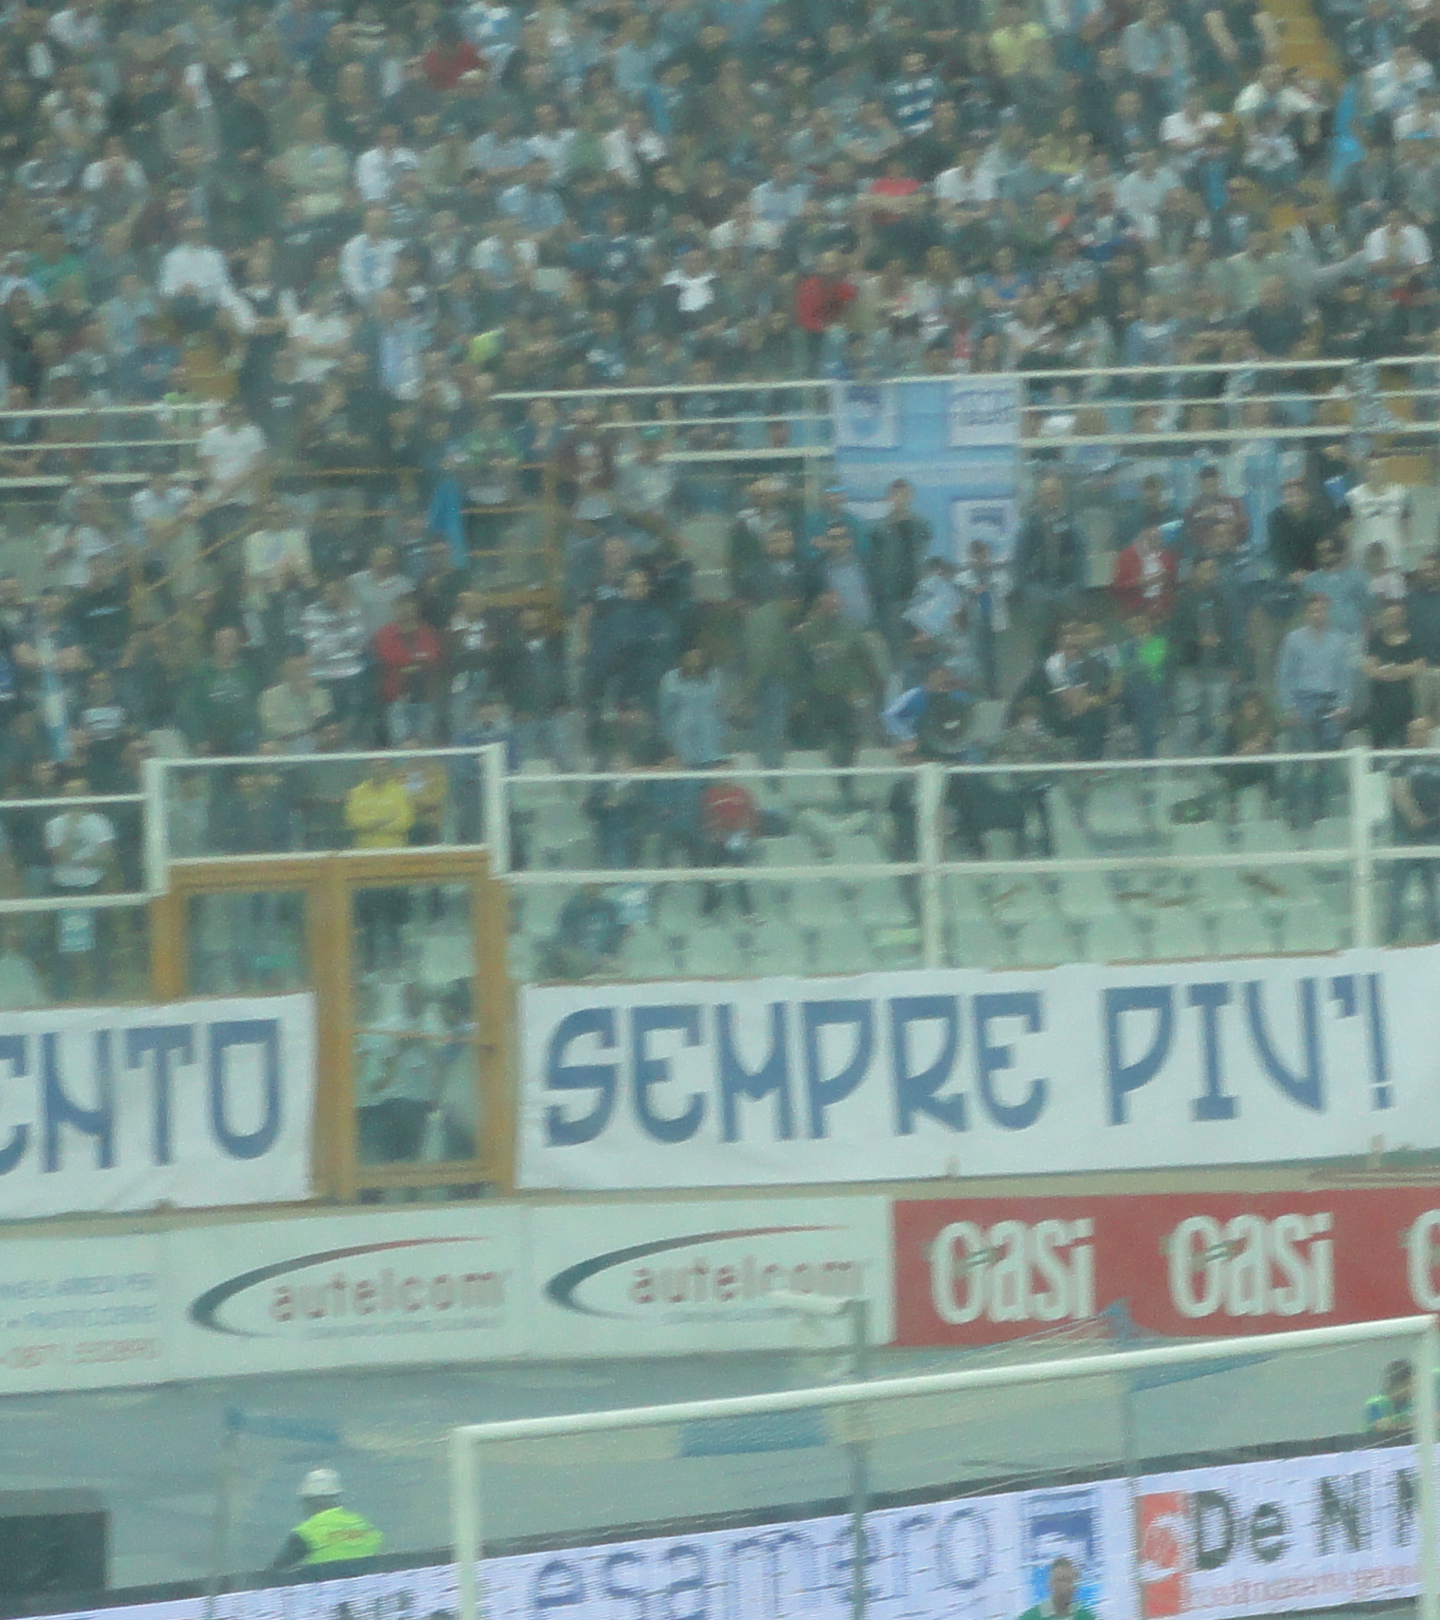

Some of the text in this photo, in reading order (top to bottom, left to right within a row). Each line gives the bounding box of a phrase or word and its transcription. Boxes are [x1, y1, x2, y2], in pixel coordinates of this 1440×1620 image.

[545, 991, 1050, 1146] SEMPRE
[272, 1269, 506, 1321] autelcom
[1193, 1488, 1293, 1570] De
